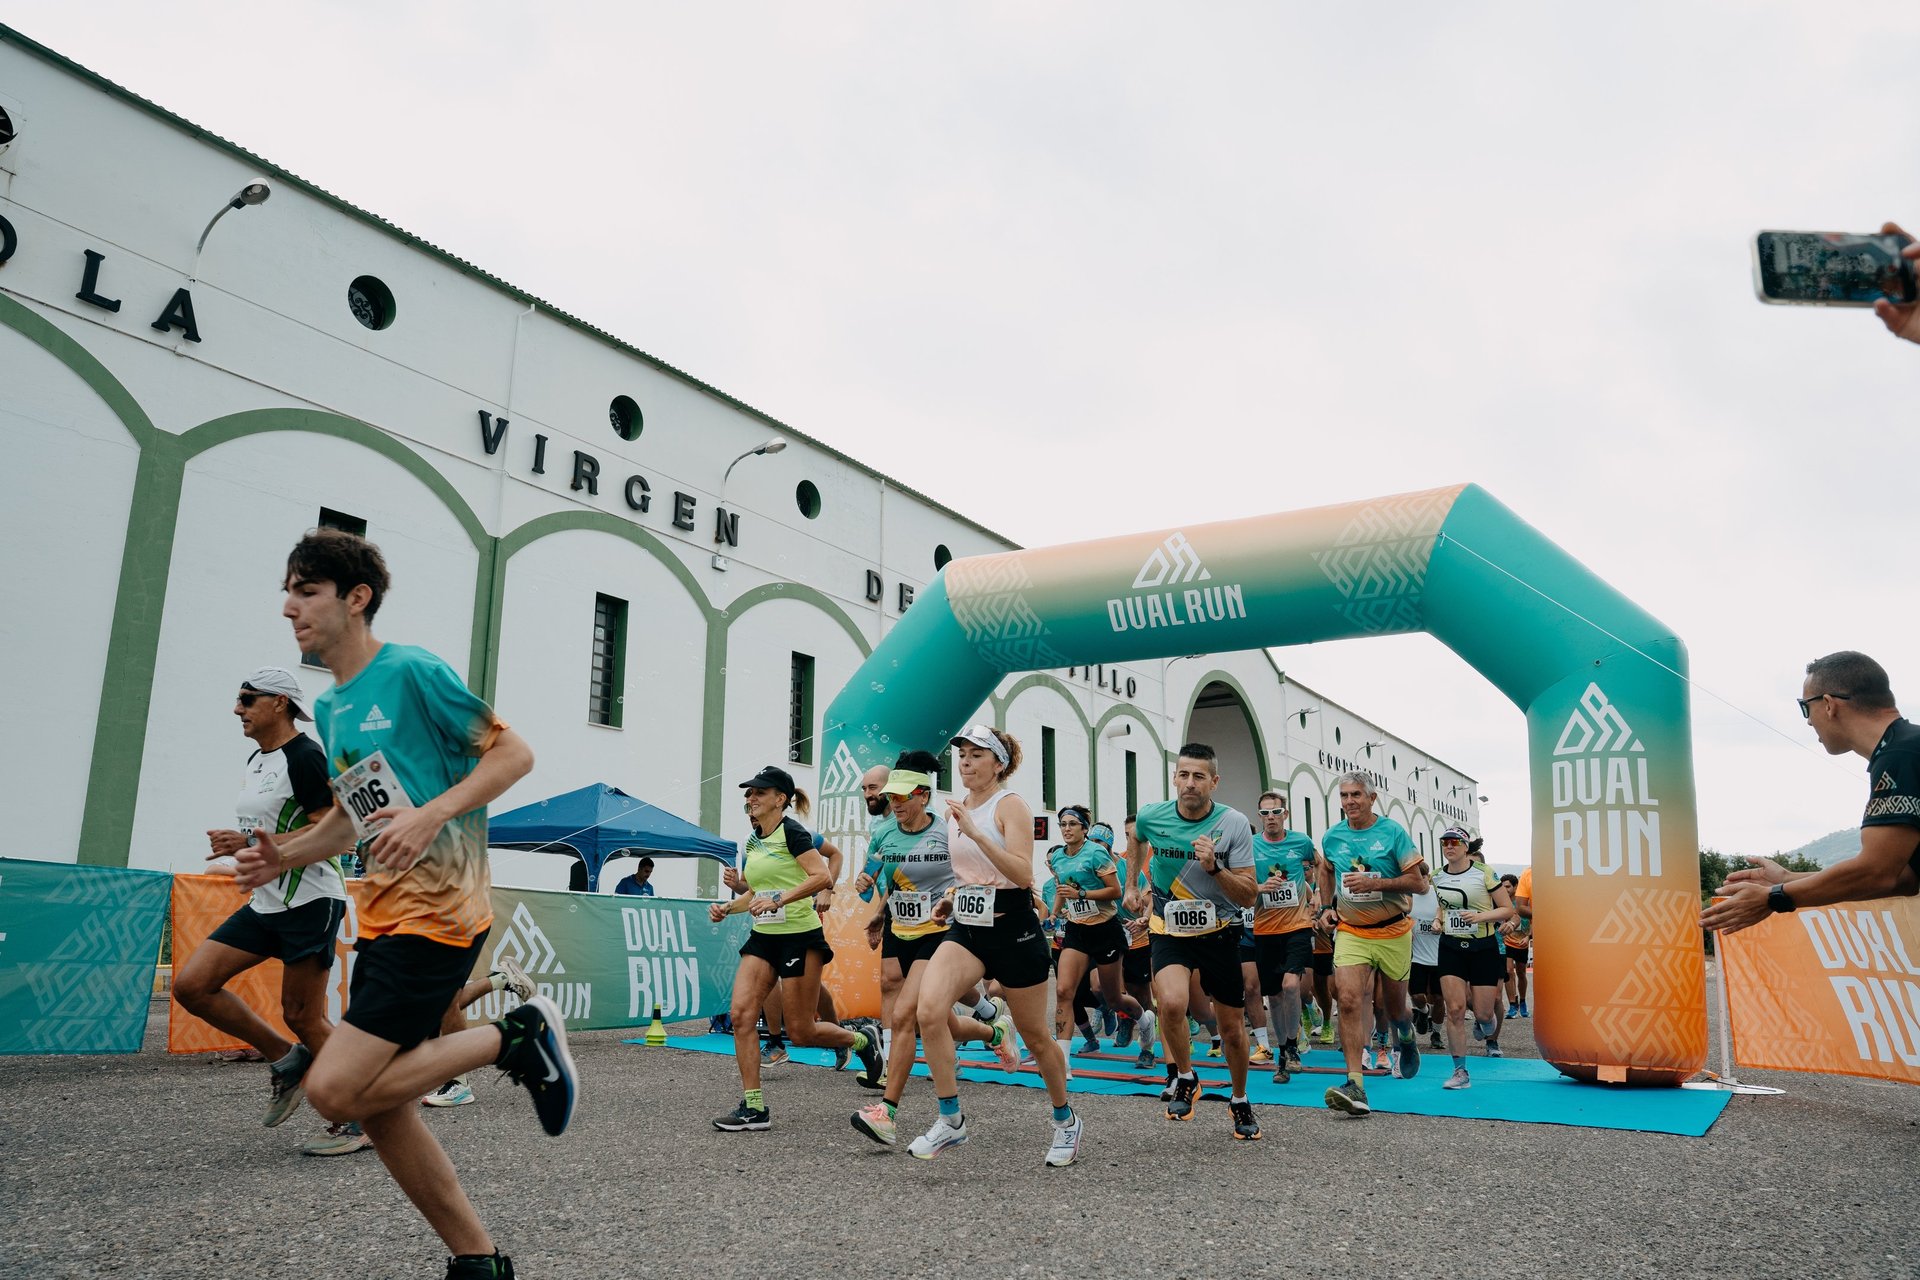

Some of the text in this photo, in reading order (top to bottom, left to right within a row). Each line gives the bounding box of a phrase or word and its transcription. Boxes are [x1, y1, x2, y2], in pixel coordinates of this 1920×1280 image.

[478, 409, 740, 547] VIRGEN
[1107, 584, 1247, 632] DUAL RUN
[347, 778, 390, 822] 1006
[1552, 757, 1659, 808] DUAL
[908, 854, 922, 863] DEL
[924, 853, 949, 862] NERVO
[1554, 810, 1662, 877] RUN
[895, 901, 922, 918] 1081
[957, 894, 986, 914] 1066
[1072, 900, 1091, 913] 1071
[1269, 889, 1292, 902] 1039
[621, 907, 697, 952] DUAL
[1172, 910, 1208, 926] 1086
[1419, 923, 1432, 932] 108
[1798, 908, 1920, 976] DUAL
[628, 956, 700, 1018] RUN
[1828, 975, 1920, 1068] RU
